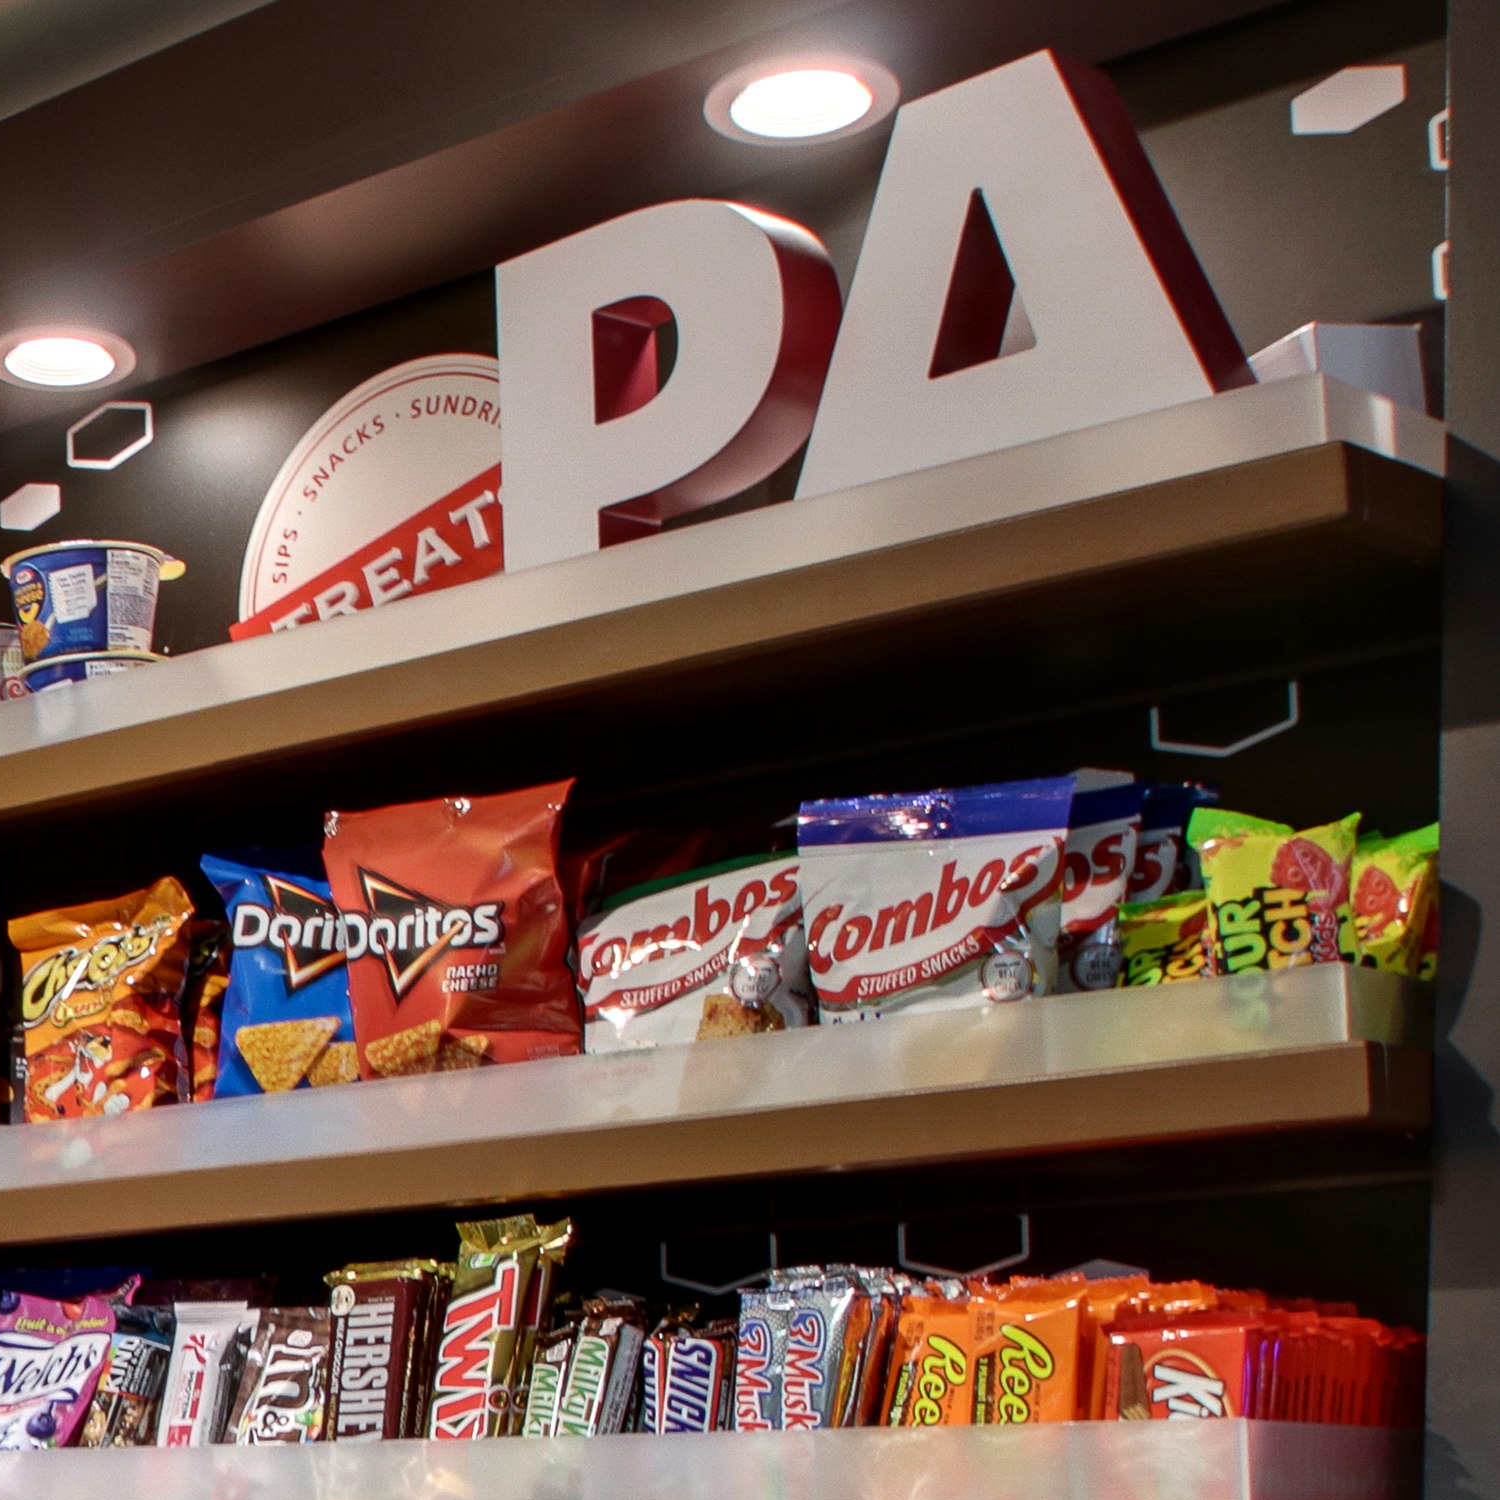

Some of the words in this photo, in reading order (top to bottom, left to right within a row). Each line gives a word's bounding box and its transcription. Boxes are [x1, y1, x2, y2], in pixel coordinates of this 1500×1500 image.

[495, 48, 1256, 573] PA
[271, 528, 299, 585] SIPS
[302, 414, 386, 502] SNACKS
[410, 394, 502, 429] SUNDRI
[270, 489, 503, 634] TREAT
[232, 903, 346, 950] Dorit
[345, 902, 502, 959] Doritos
[809, 844, 1046, 974] Combos
[1263, 887, 1313, 972] TCH
[441, 978, 499, 993] CHEESE
[446, 963, 499, 979] NACHO
[620, 981, 682, 1007] STUFFED
[684, 945, 740, 988] SNACK
[857, 968, 917, 996] STUFFED
[920, 935, 981, 979] SNACKS
[103, 1336, 141, 1392] KIND
[336, 1301, 395, 1442] HERSHE
[665, 1338, 715, 1433] SNICK
